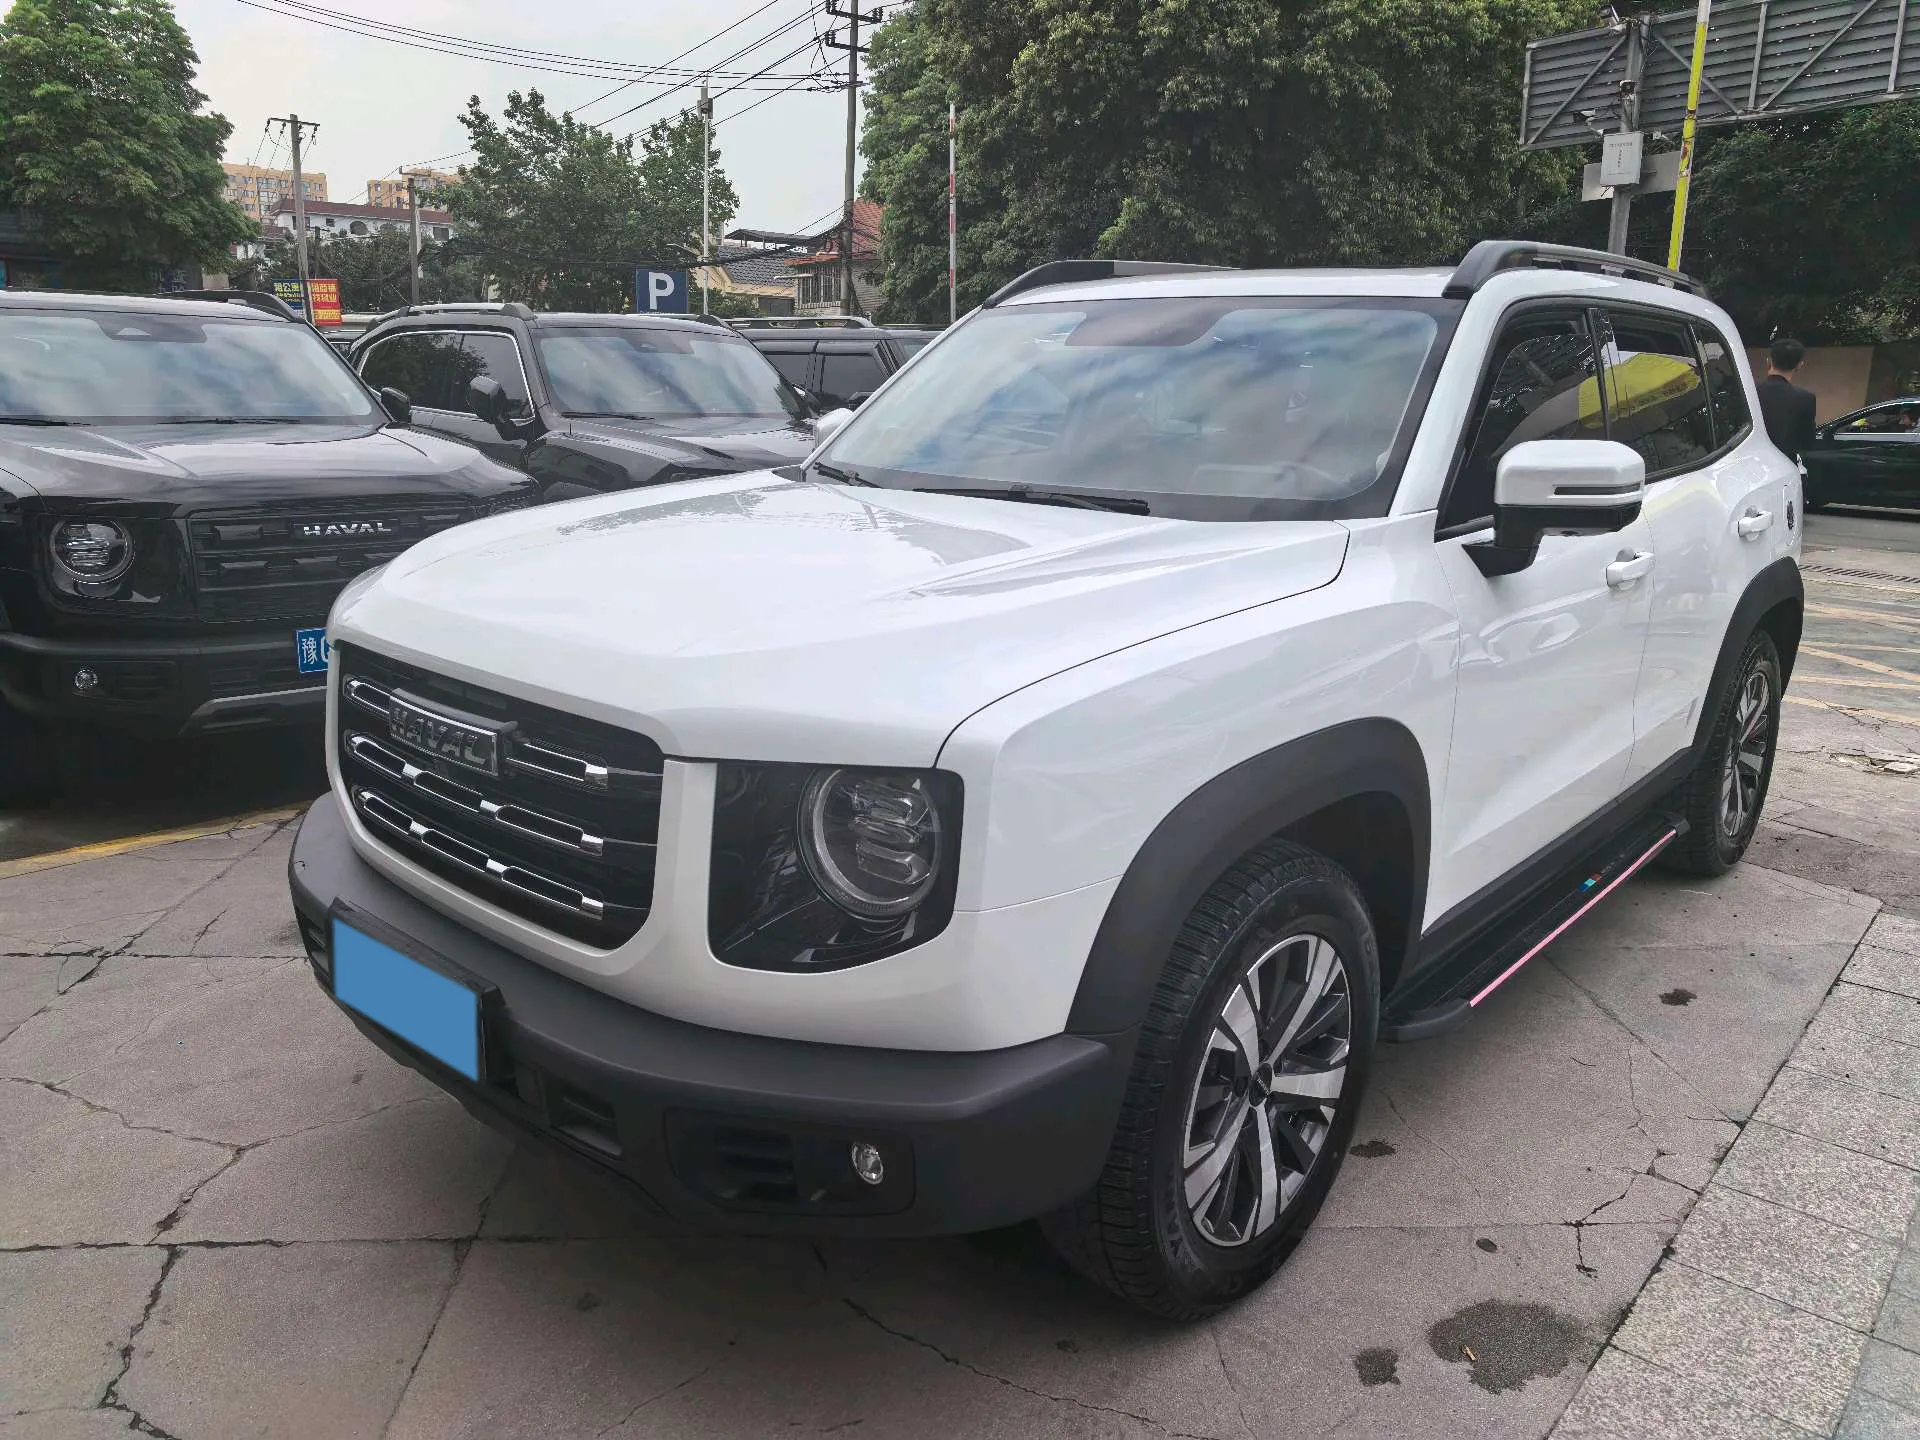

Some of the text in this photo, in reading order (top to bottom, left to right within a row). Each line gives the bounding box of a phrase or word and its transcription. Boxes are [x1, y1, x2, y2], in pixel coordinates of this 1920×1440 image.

[649, 272, 675, 310] P
[303, 522, 392, 536] HAVAL
[389, 707, 487, 765] HAVAL
